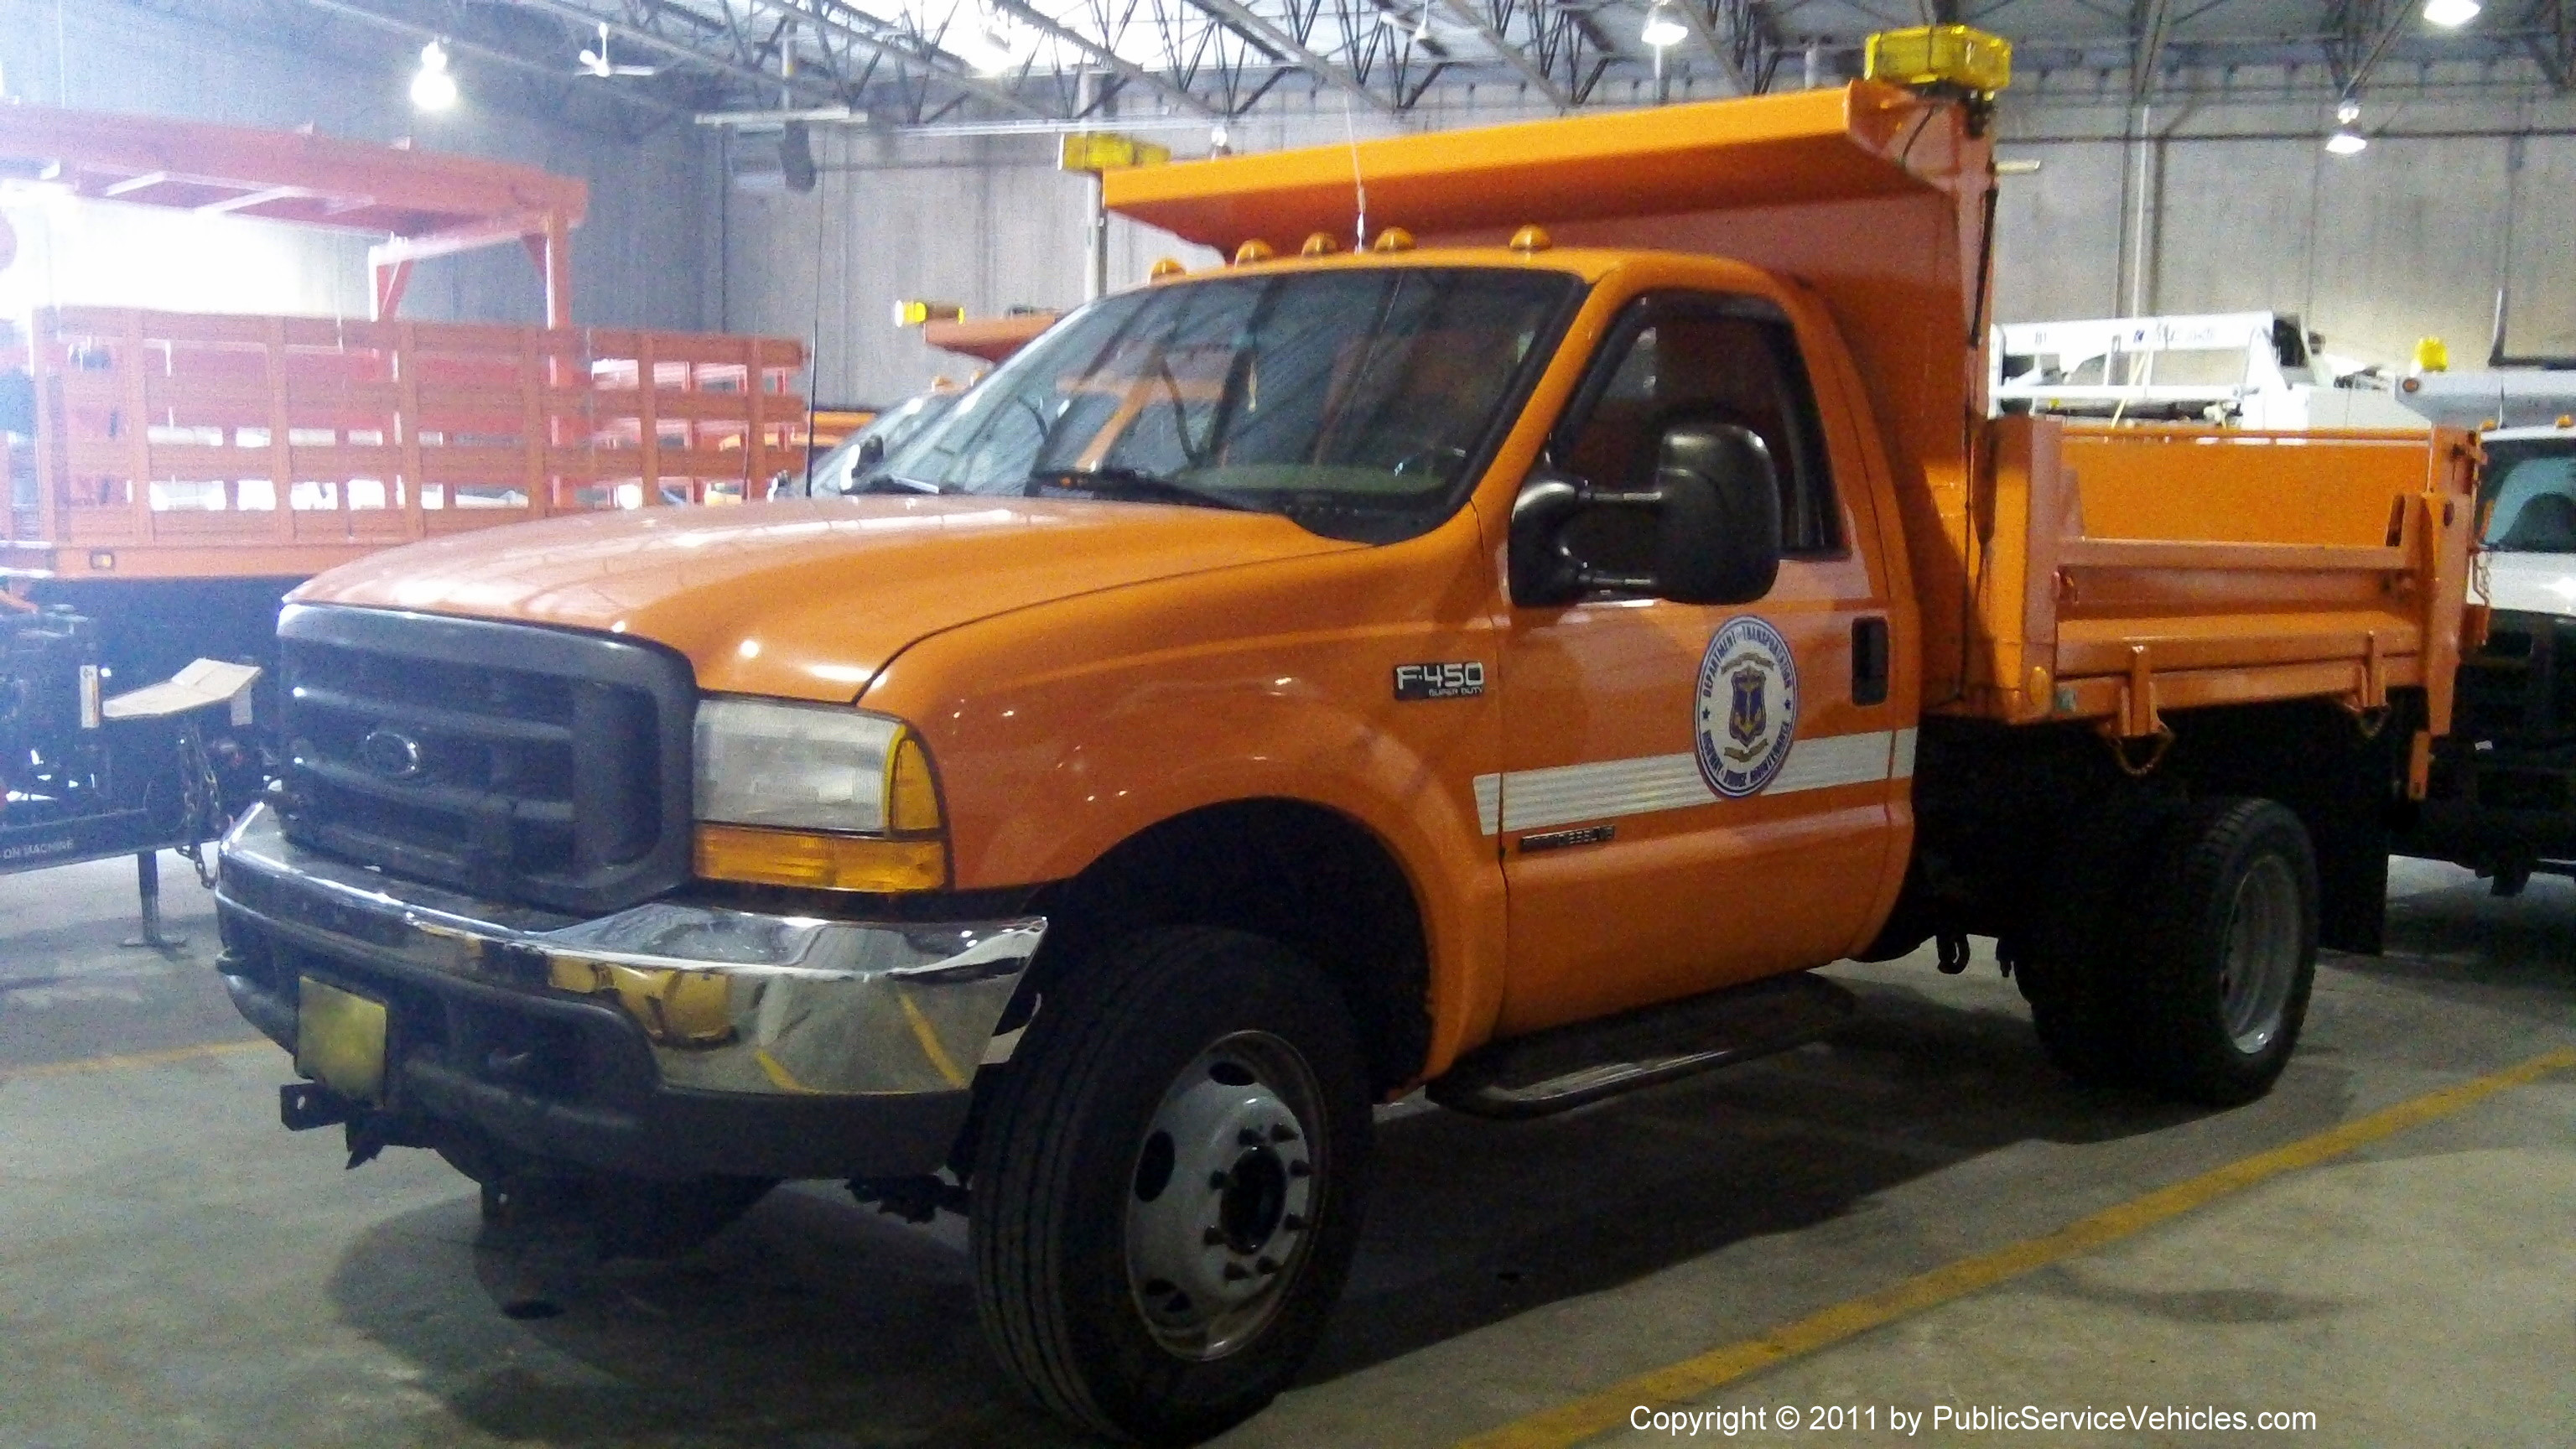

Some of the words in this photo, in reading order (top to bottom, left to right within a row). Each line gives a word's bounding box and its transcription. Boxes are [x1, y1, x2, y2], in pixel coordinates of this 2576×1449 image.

[1396, 662, 1483, 689] F-450
[1428, 688, 1457, 697] SUPER
[1461, 686, 1483, 695] DUTY
